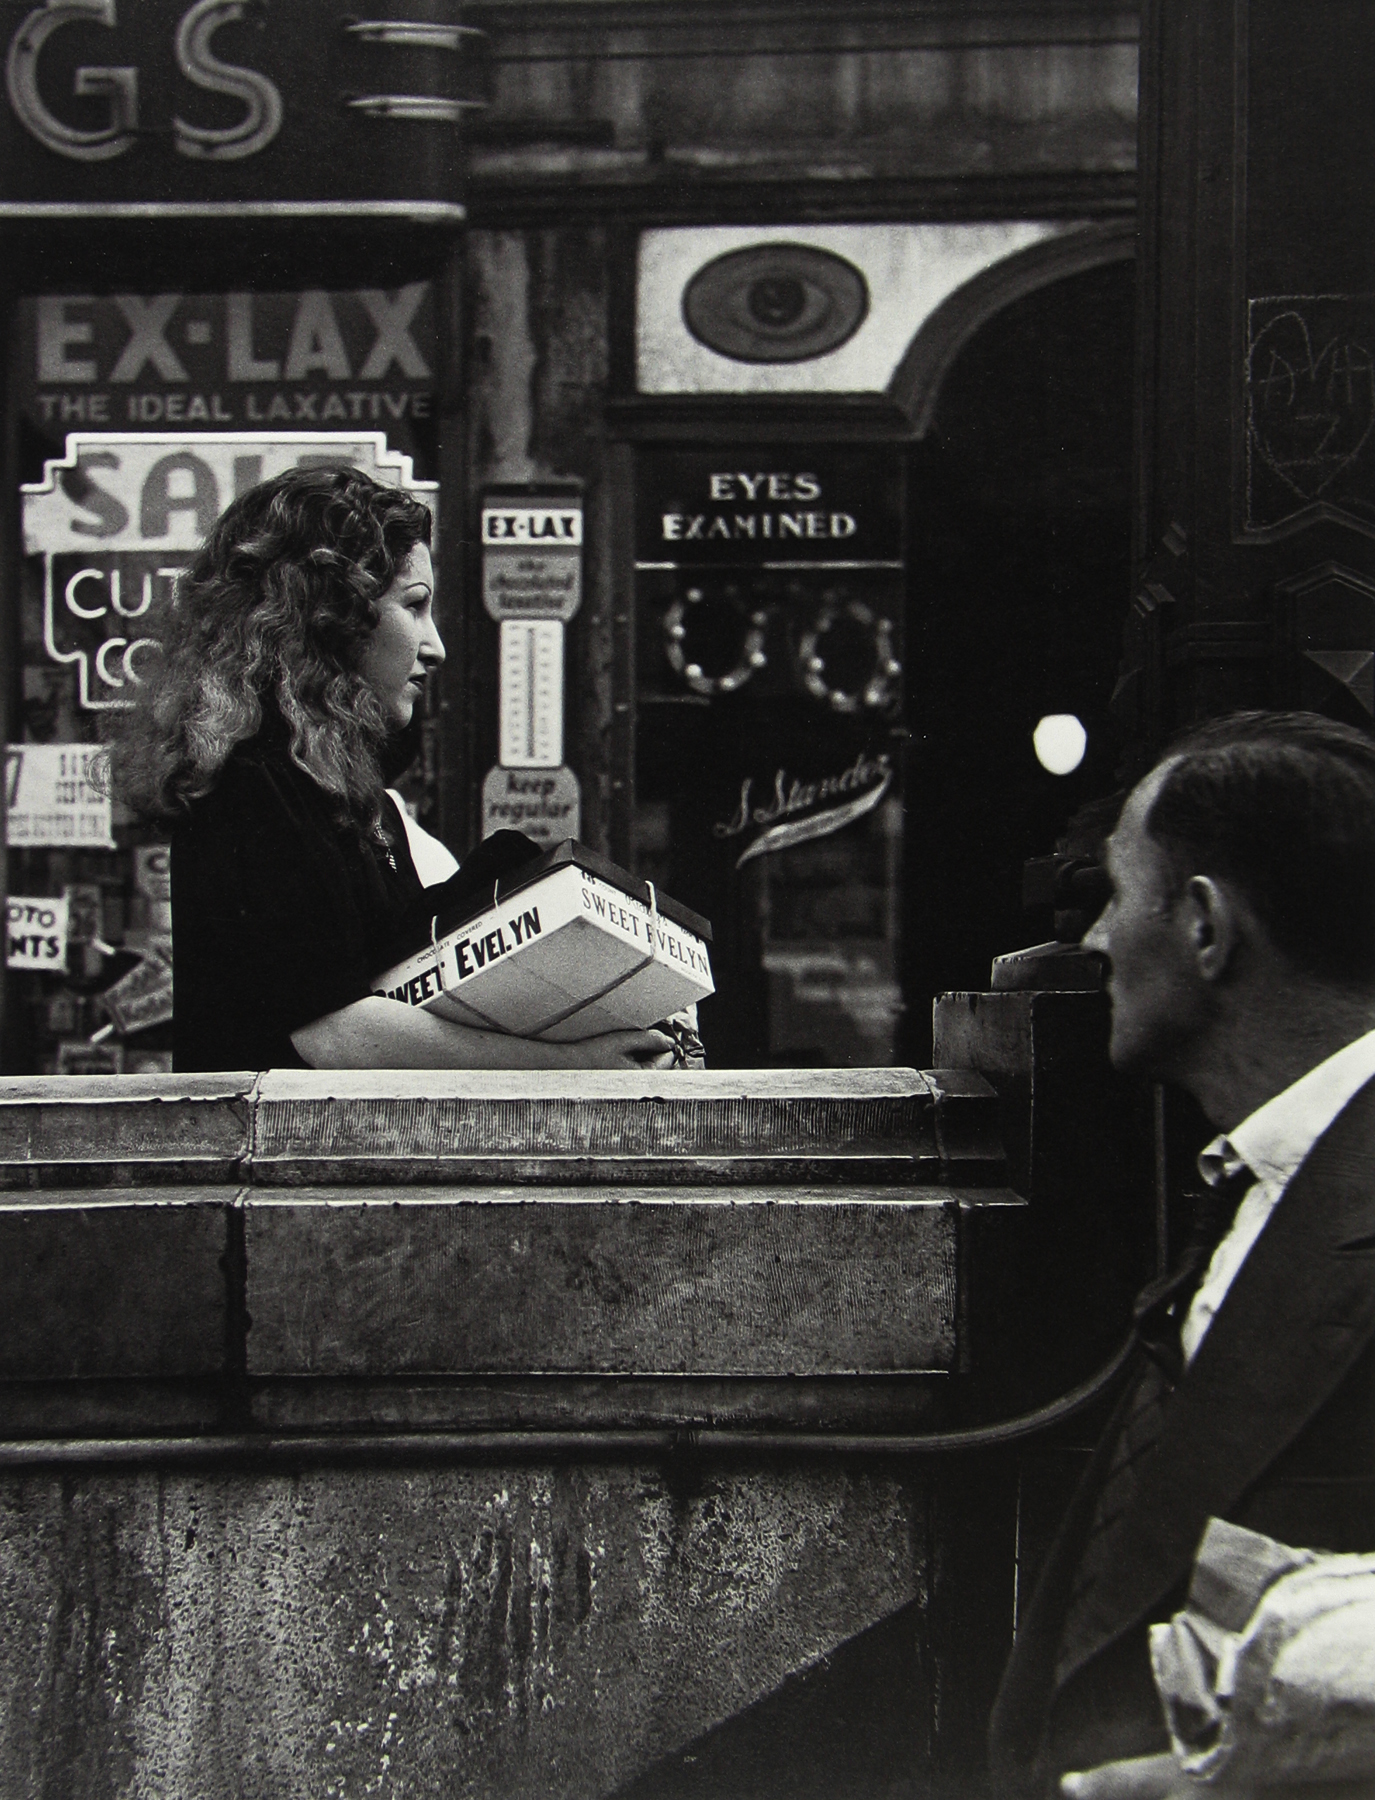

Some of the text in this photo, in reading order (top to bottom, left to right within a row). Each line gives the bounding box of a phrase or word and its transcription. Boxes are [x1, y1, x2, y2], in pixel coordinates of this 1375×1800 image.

[7, 0, 283, 160] GS
[42, 391, 431, 422] THE IDEAL LAXATIVE
[710, 473, 821, 501] EYES
[662, 512, 857, 541] EXAMINED
[65, 567, 194, 619] CUT
[488, 800, 572, 824] regular
[454, 906, 543, 980] EVELYN
[456, 920, 483, 941] COVERED
[581, 887, 639, 937] SWEET
[645, 922, 709, 978] EVELYN
